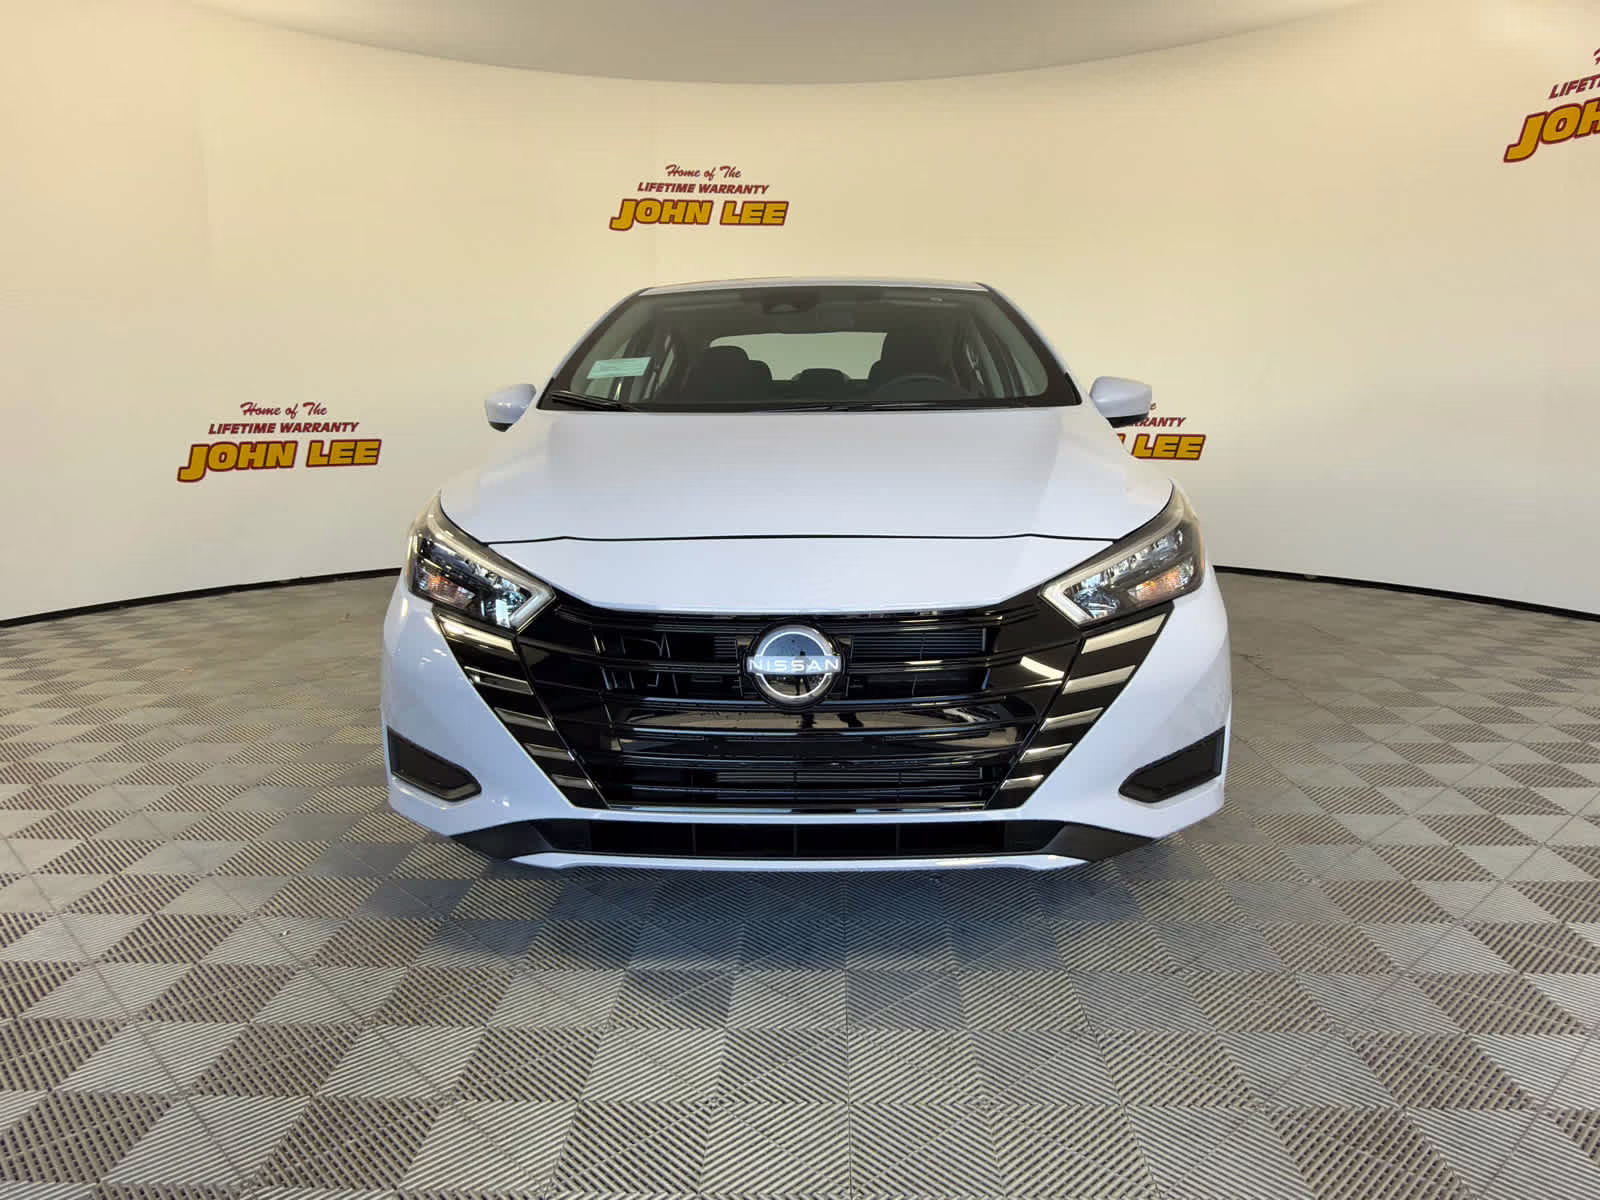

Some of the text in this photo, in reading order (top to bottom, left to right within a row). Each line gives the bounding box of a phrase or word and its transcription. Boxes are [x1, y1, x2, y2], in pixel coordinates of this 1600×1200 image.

[1548, 74, 1600, 99] LIFET
[1503, 97, 1600, 163] JOH
[665, 164, 742, 181] Home of The
[637, 182, 770, 195] LIFETIME WARRANTY
[609, 198, 789, 231] JOHN LEE
[240, 401, 328, 419] Home of The
[208, 421, 360, 435] LIFETIME WARRANTY
[1131, 433, 1207, 461] LEE
[177, 438, 382, 483] JOHN LEE
[748, 658, 840, 672] NISSAN
